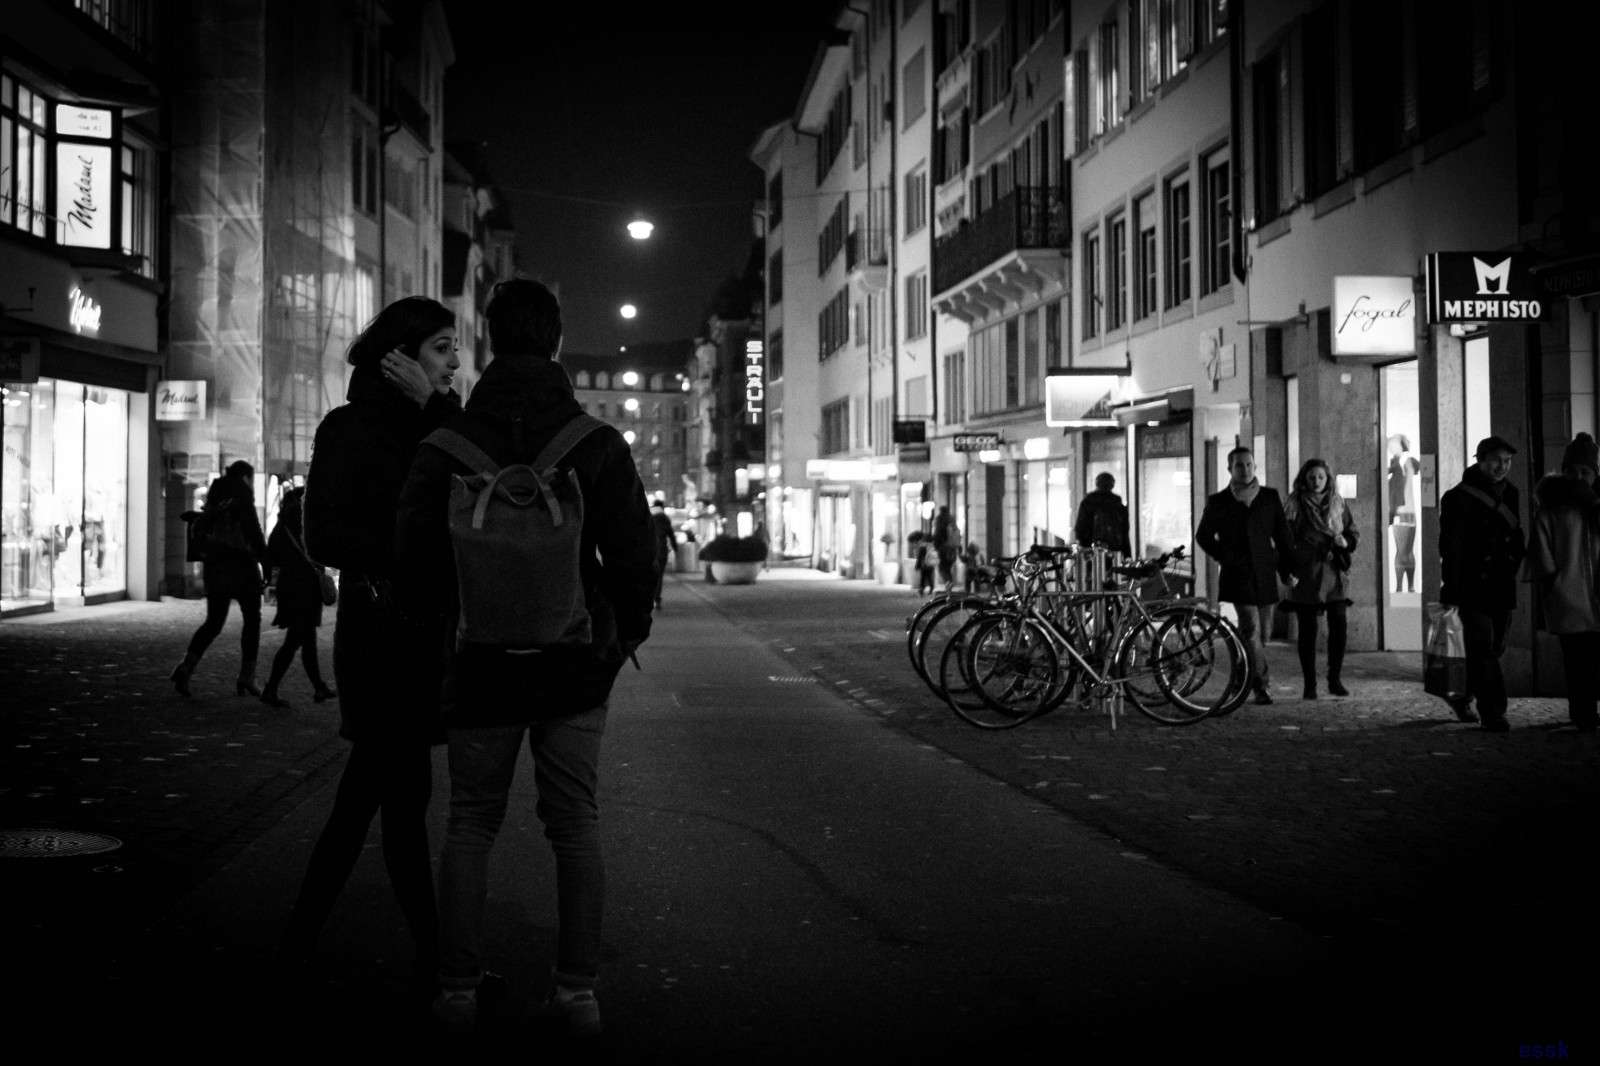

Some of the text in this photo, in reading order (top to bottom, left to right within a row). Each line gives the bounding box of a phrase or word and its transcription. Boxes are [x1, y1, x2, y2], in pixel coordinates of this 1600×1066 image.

[1338, 295, 1411, 334] fogal
[1443, 300, 1542, 318] MEPHISTO
[746, 340, 764, 424] STRÄULI
[955, 435, 998, 445] GEOX
